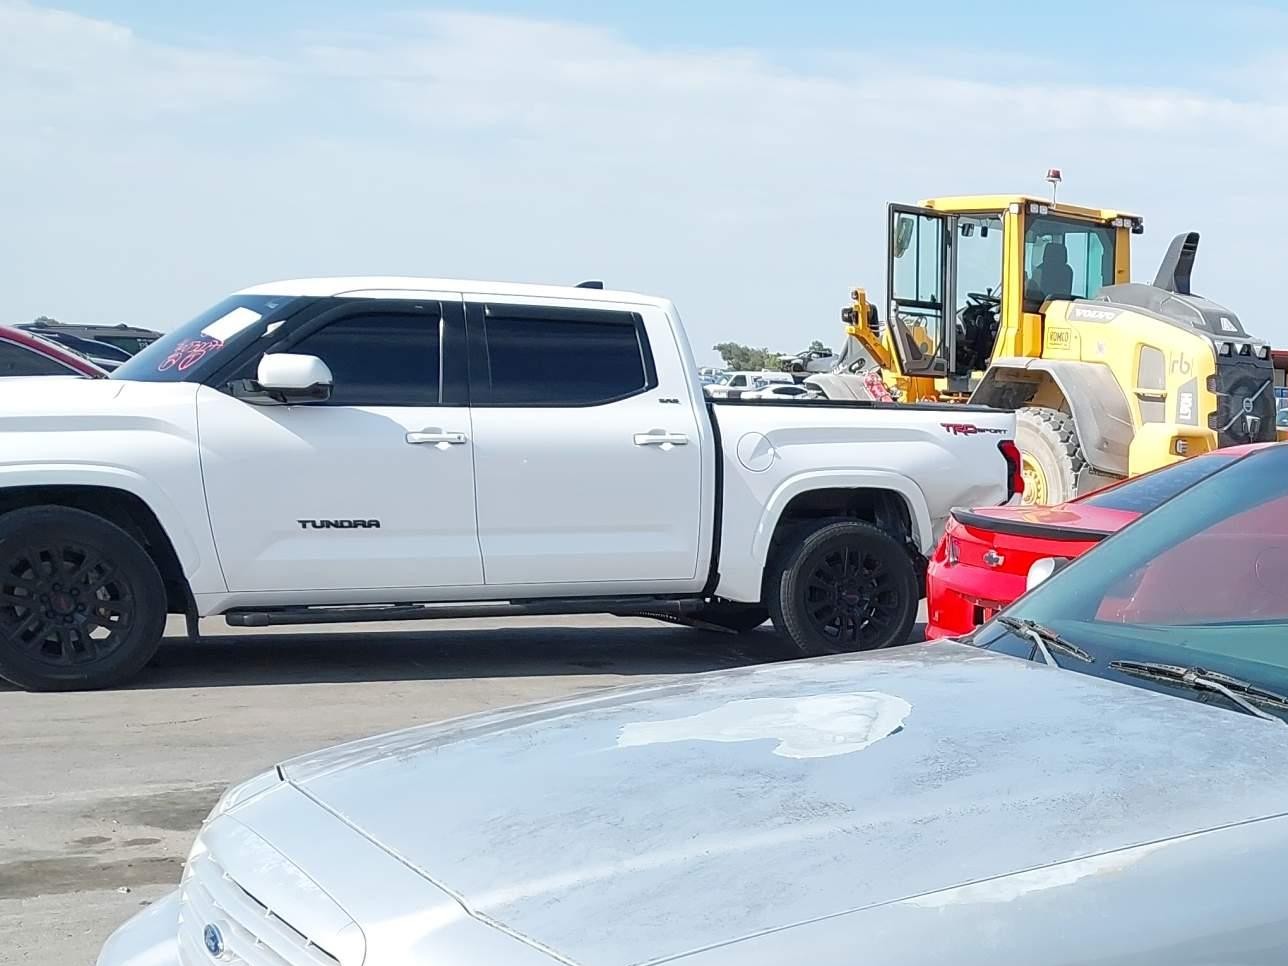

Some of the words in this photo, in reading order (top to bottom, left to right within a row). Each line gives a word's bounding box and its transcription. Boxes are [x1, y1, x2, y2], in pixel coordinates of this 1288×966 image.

[1075, 308, 1117, 320] VOLVO
[940, 422, 977, 436] TRD
[297, 519, 381, 529] TUNDRA
